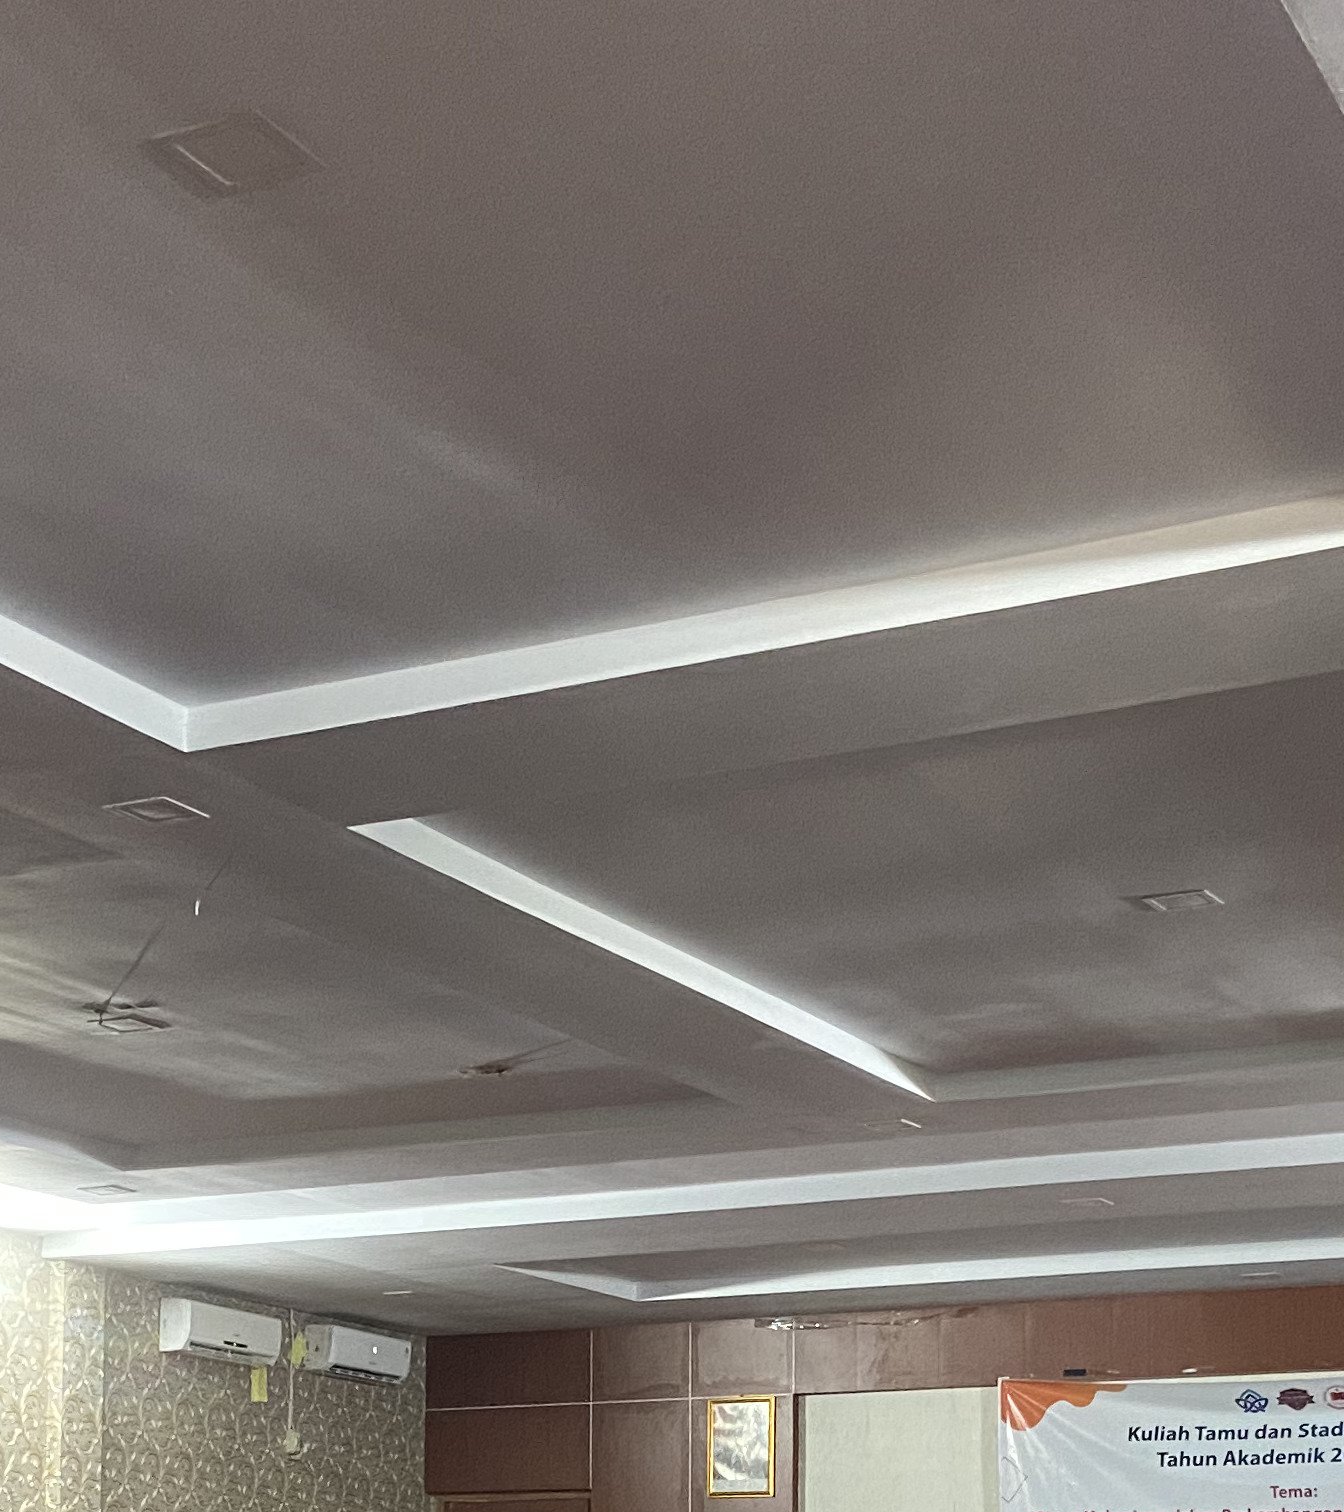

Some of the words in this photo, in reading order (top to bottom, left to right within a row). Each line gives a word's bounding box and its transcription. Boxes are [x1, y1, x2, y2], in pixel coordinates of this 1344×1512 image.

[1128, 1425, 1190, 1442] Kuliah
[1196, 1426, 1249, 1441] Tamu
[1255, 1424, 1292, 1440] dan
[1157, 1451, 1217, 1467] Tahun
[1223, 1448, 1325, 1466] Akademik
[1270, 1485, 1318, 1499] Tema:
